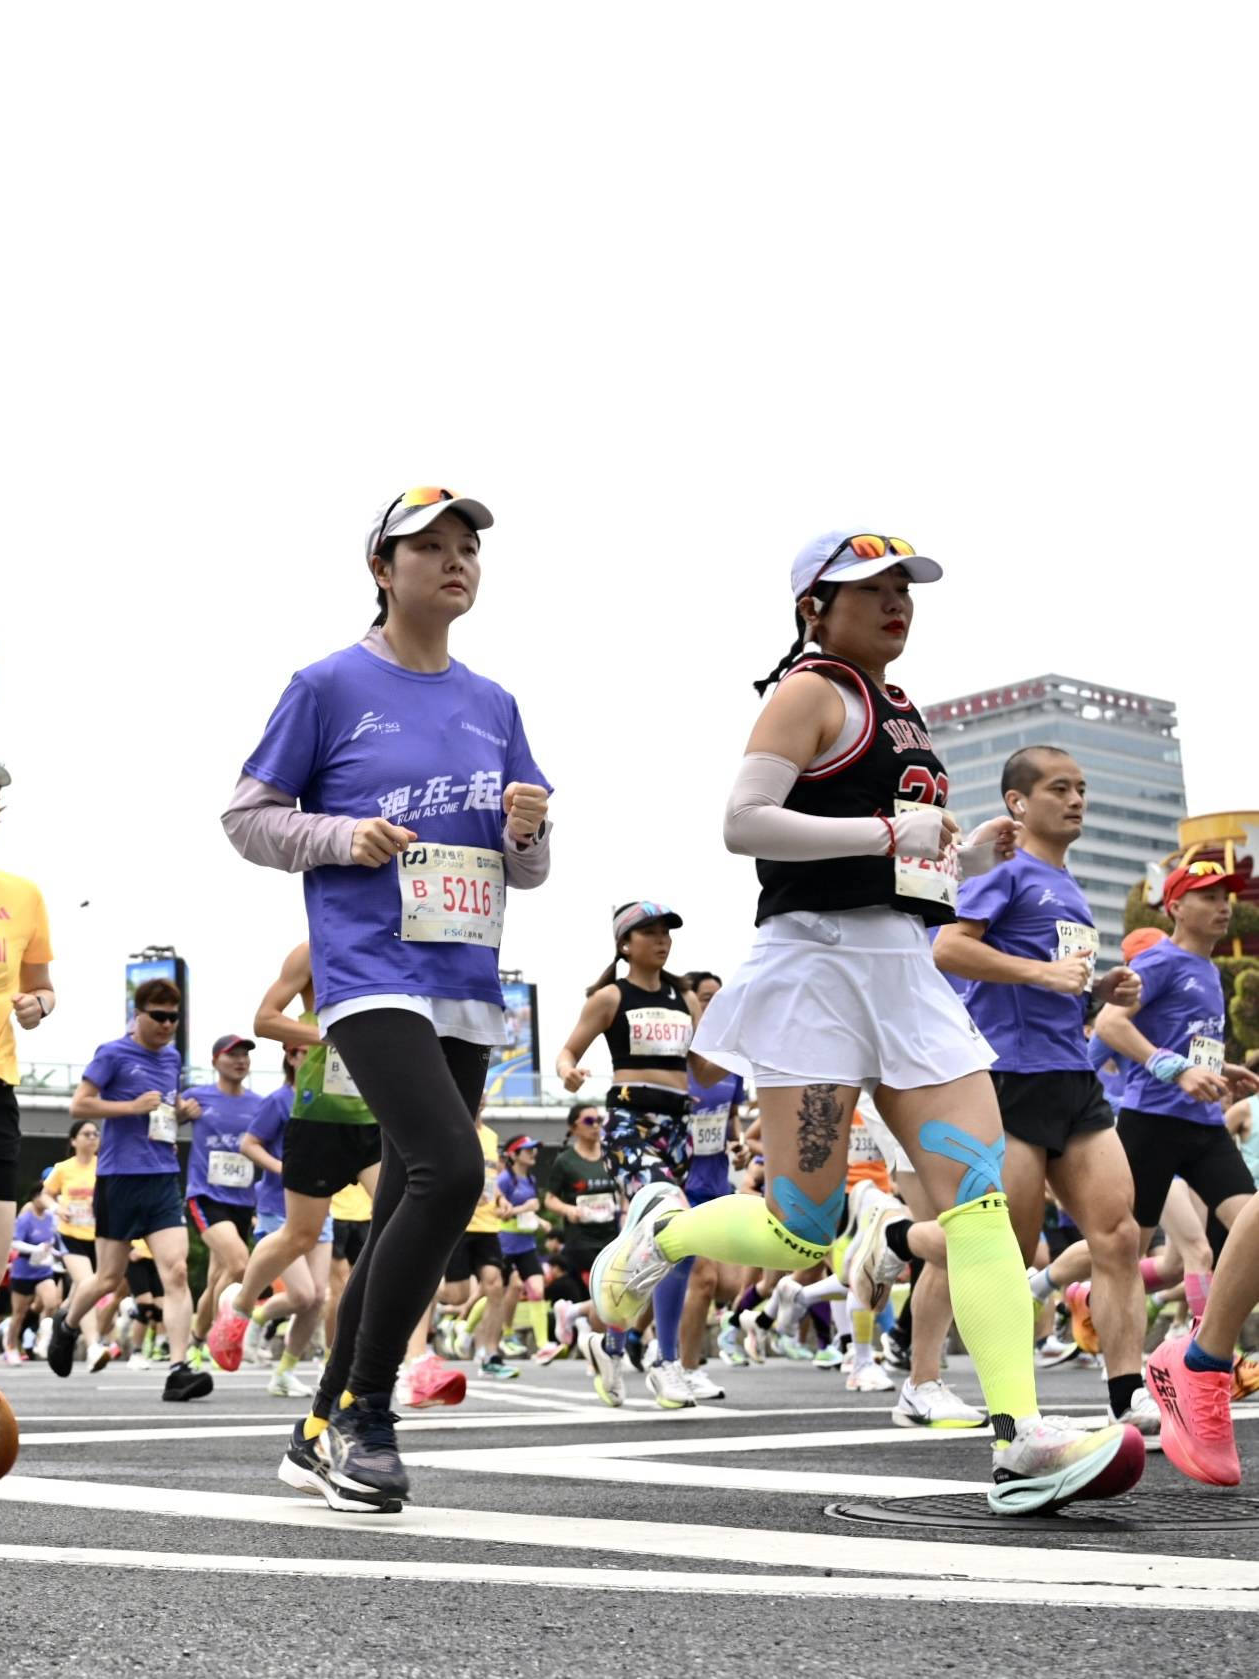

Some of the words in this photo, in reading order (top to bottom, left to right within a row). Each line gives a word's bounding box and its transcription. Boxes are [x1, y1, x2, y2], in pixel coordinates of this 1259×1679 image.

[397, 808, 422, 825] RUN
[423, 804, 438, 817] AS
[439, 802, 459, 814] ONE
[412, 880, 428, 898] B
[443, 876, 491, 916] 5216
[332, 1061, 340, 1072] B
